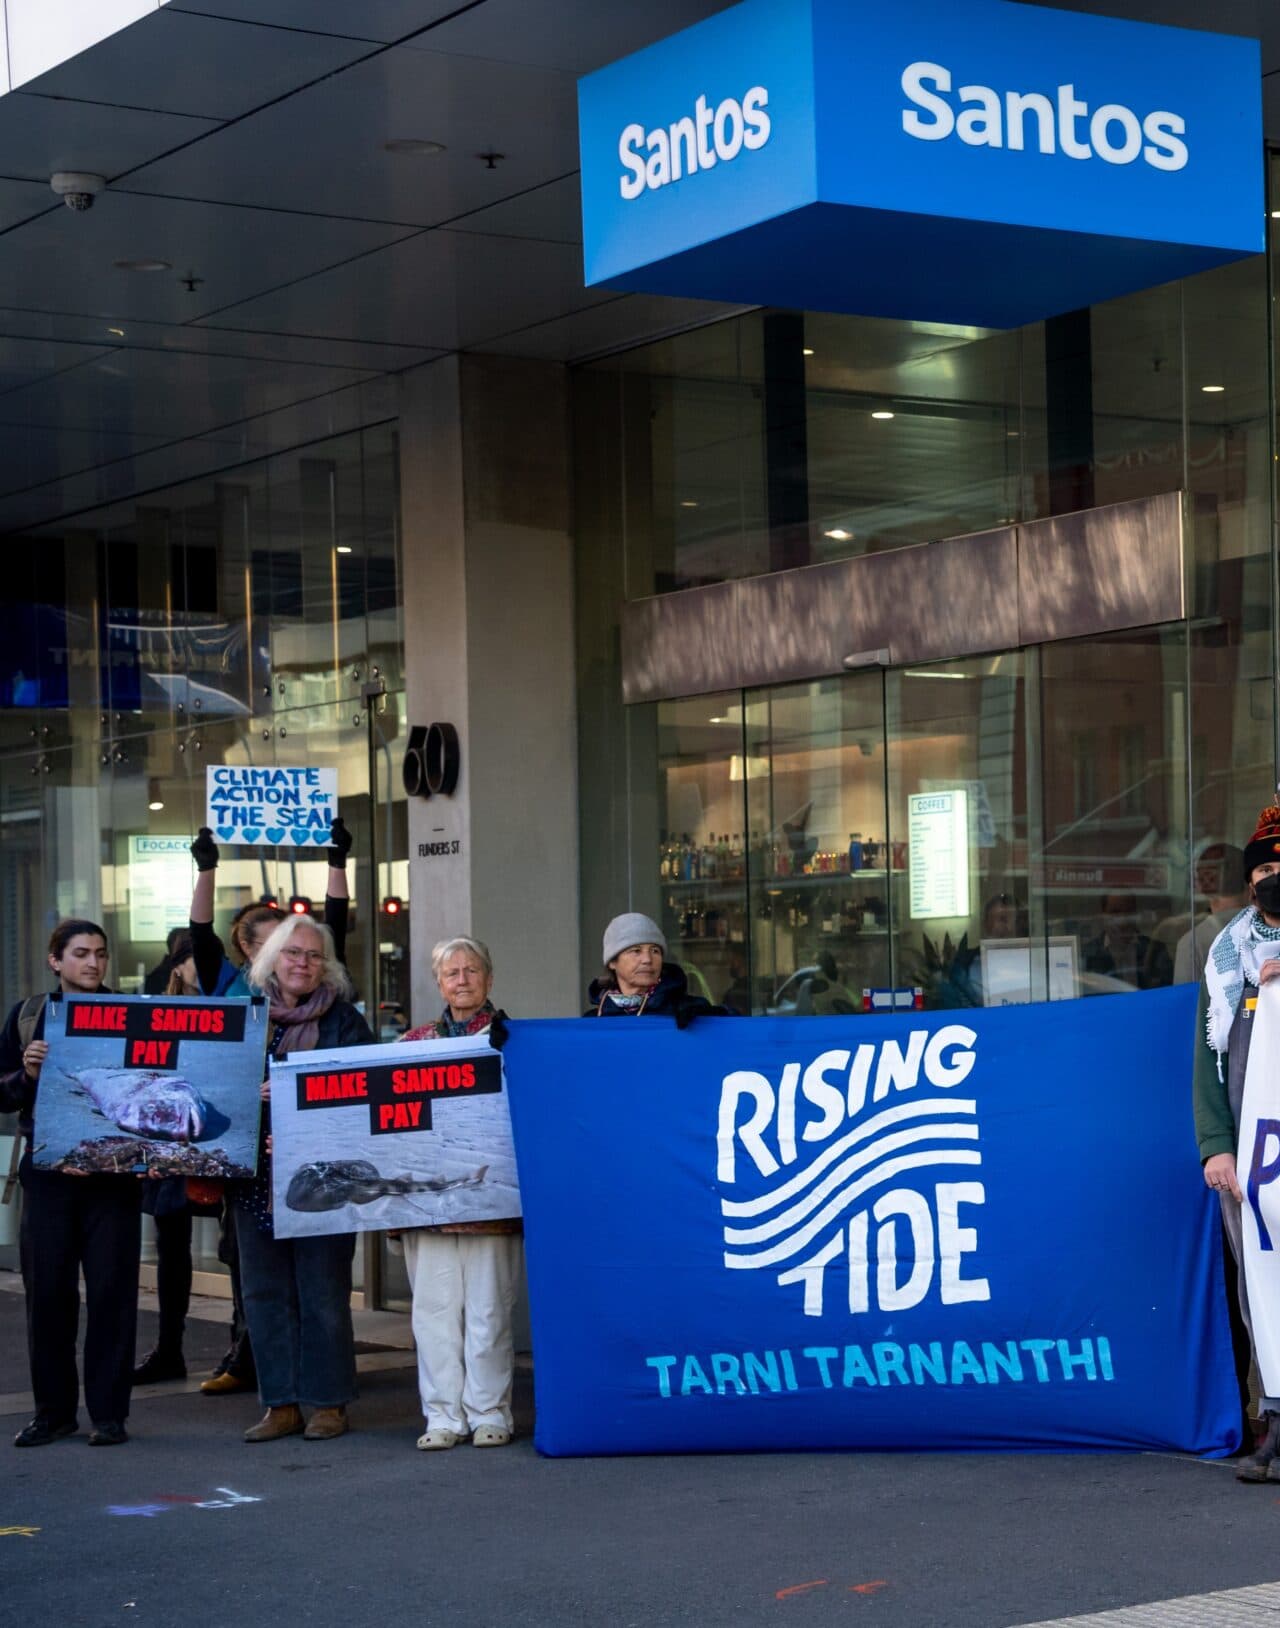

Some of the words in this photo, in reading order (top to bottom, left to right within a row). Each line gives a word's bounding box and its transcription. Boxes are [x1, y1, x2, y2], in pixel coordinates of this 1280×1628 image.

[901, 62, 1188, 171] Santos
[617, 86, 771, 200] Santos
[402, 722, 460, 799] 60
[214, 767, 320, 786] CLIMATE
[210, 786, 301, 806] ACTION
[307, 789, 333, 805] for
[917, 799, 945, 811] COFFEE
[210, 805, 266, 827] THE
[276, 807, 332, 829] SEA!
[451, 840, 461, 855] ST
[73, 1005, 127, 1031] MAKE
[151, 1008, 225, 1034] SANTOS
[132, 1040, 170, 1065] PAY
[305, 1071, 368, 1102] MAKE
[392, 1063, 476, 1095] SANTOS
[379, 1101, 423, 1130] PAY
[717, 1024, 978, 1184] RISING
[778, 1181, 991, 1317] TIDE
[646, 1350, 798, 1398] TARNI
[803, 1336, 1115, 1389] TARNANTHI
